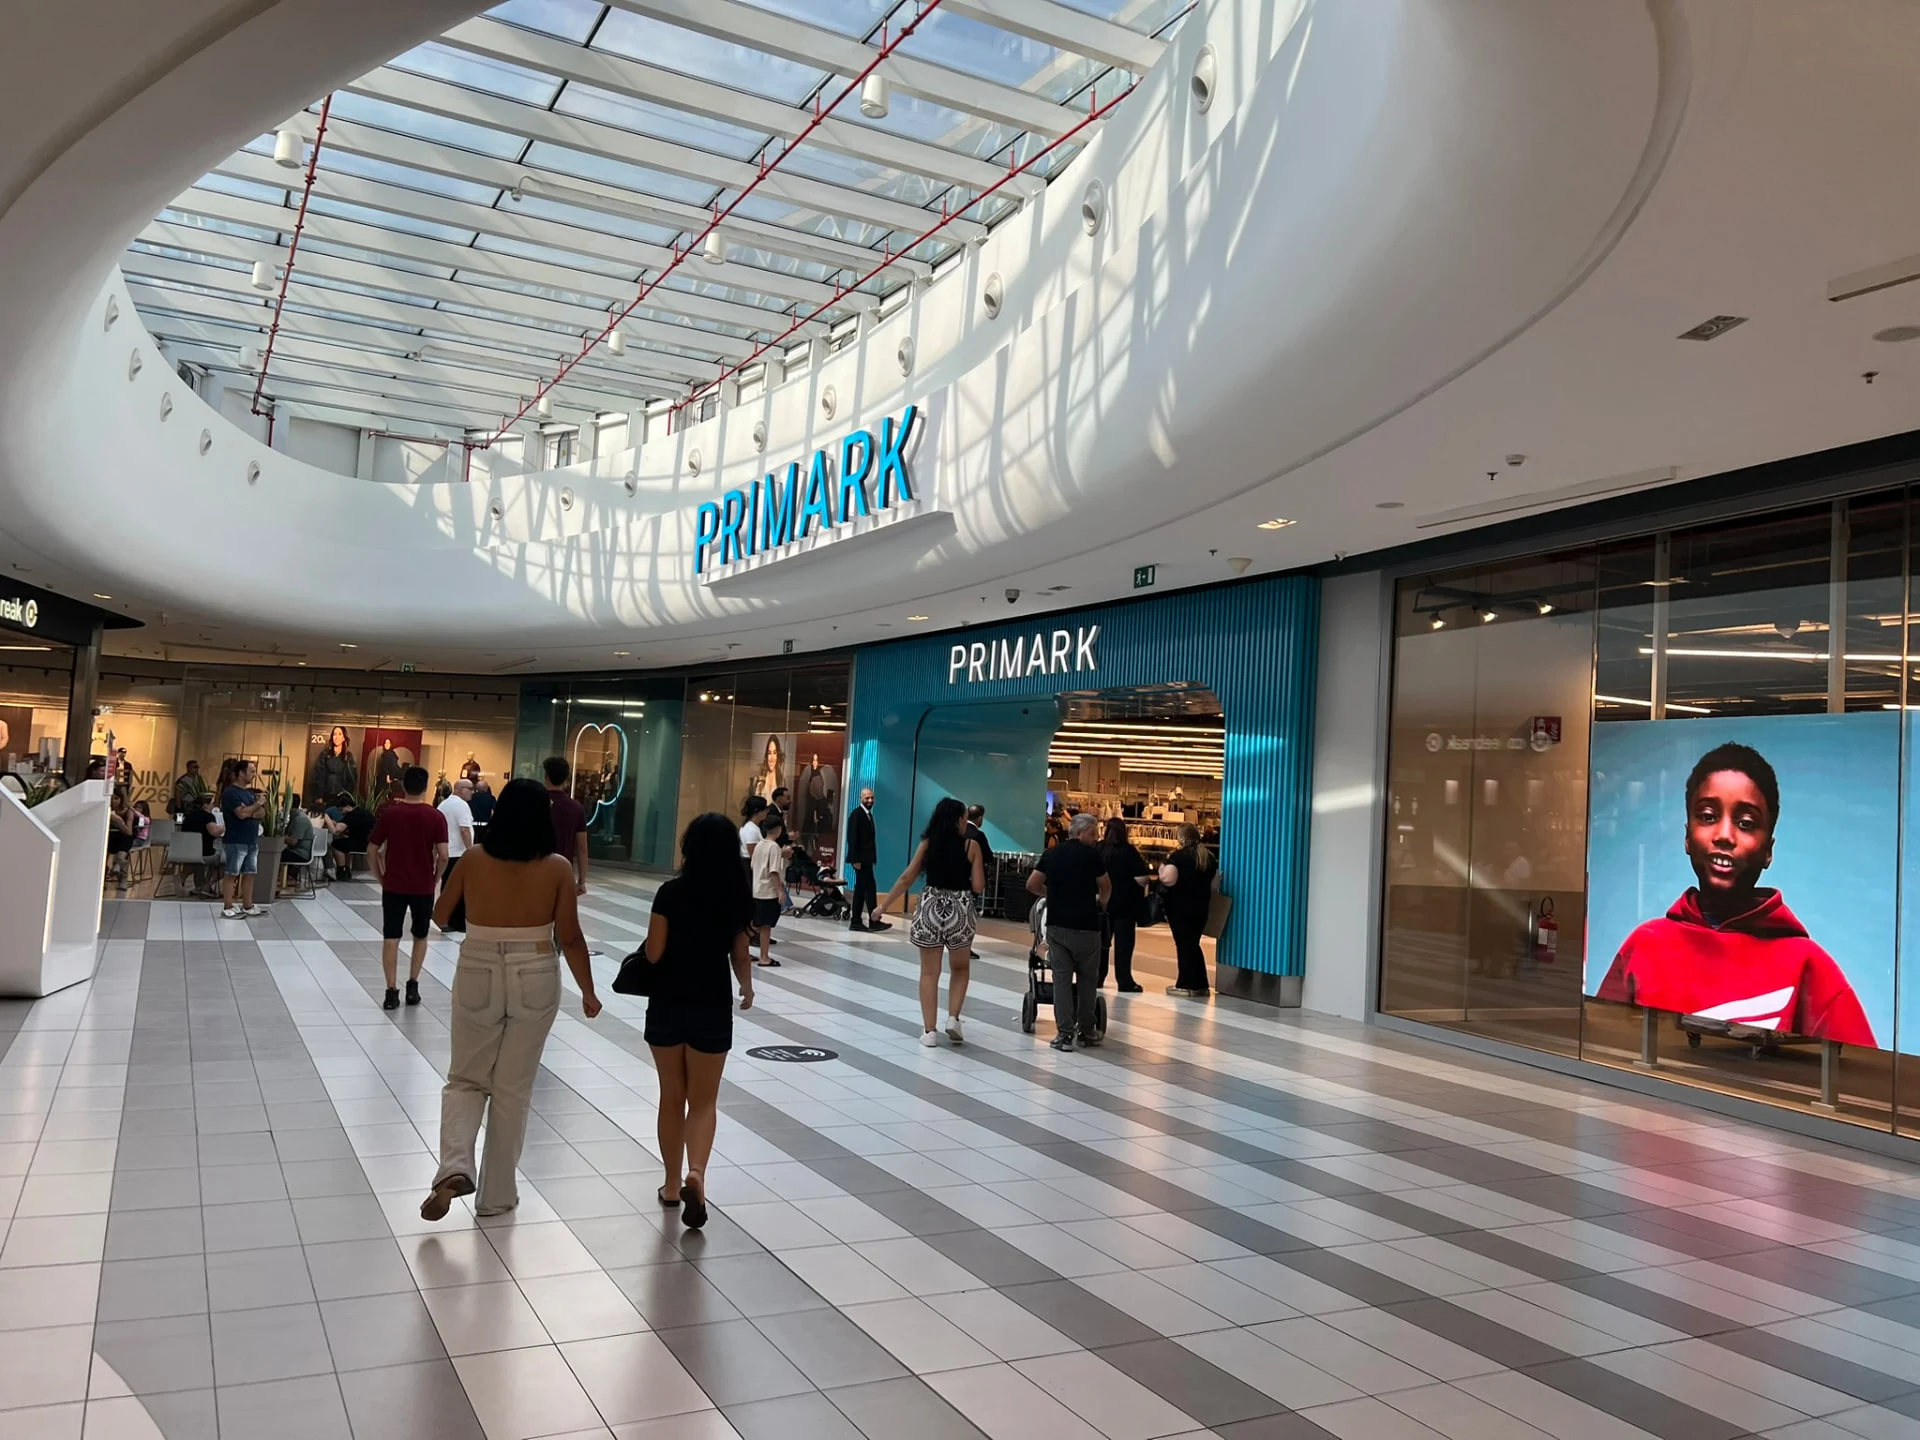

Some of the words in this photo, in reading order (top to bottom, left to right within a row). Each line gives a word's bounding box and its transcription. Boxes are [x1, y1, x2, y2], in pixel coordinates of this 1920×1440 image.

[695, 405, 917, 574] PRIMARK
[949, 624, 1100, 684] PRIMARK
[129, 786, 171, 804] /26
